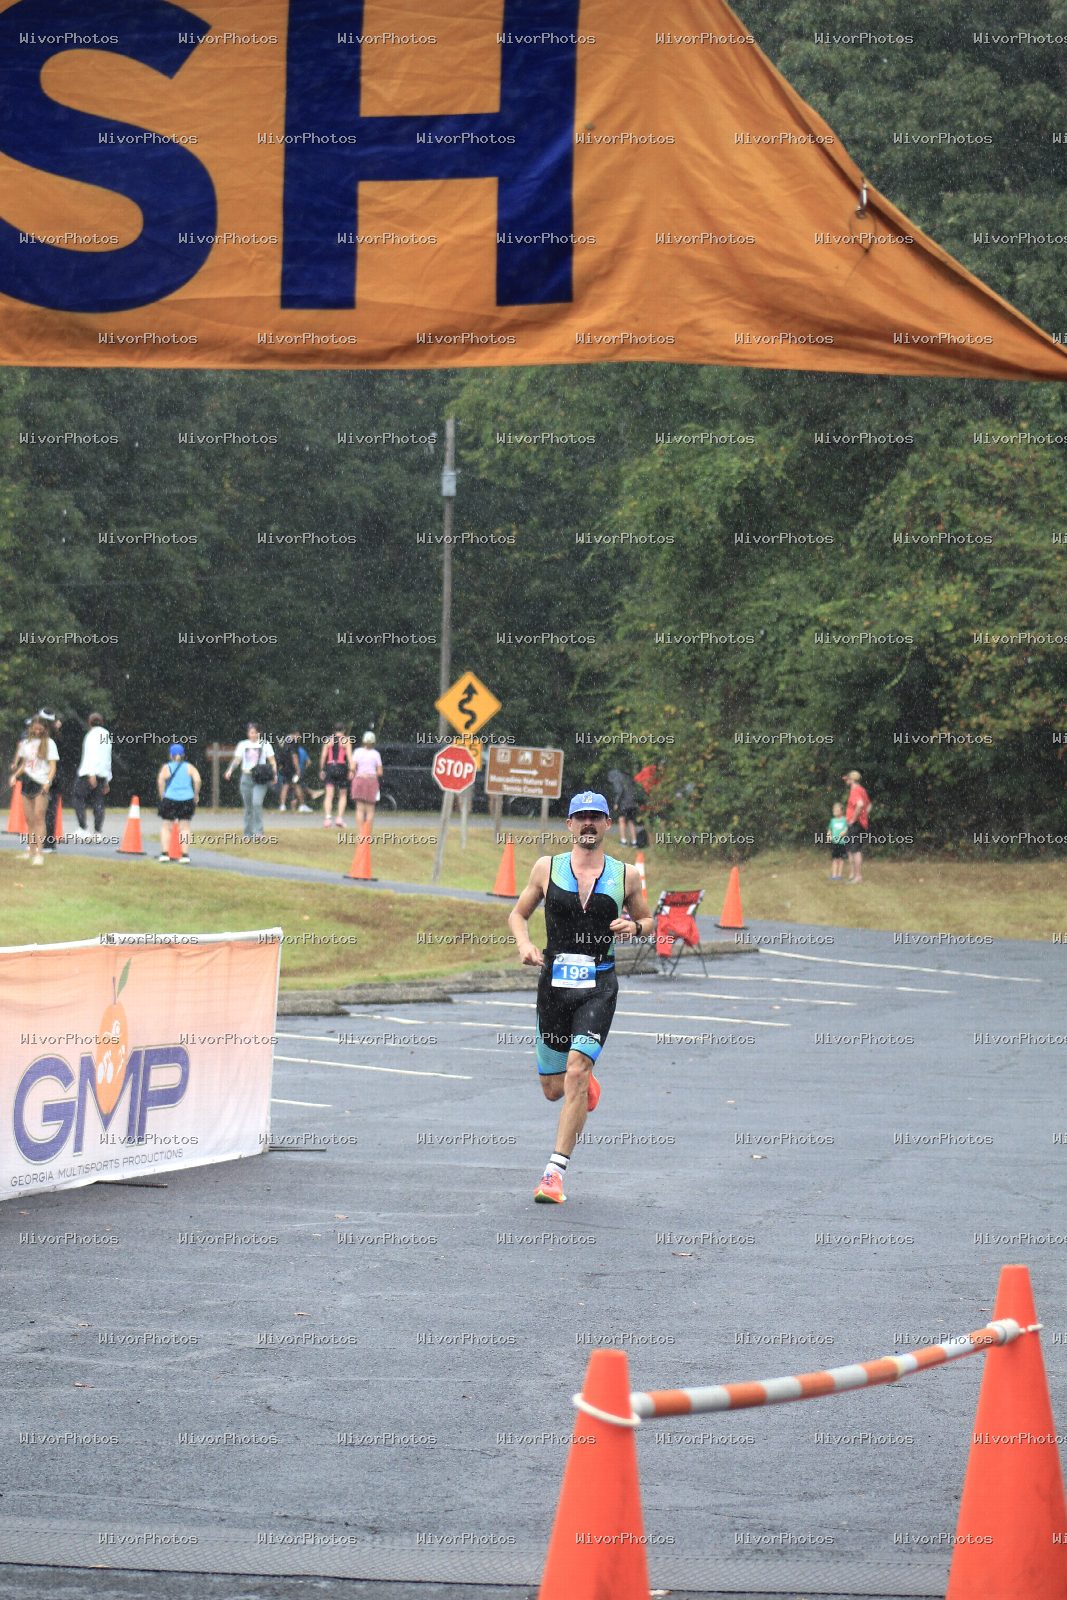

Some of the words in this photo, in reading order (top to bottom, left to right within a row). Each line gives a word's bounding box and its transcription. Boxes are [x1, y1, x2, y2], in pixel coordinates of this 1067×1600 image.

[0, 0, 579, 313] SH
[436, 757, 473, 779] STOP
[561, 965, 589, 980] 198
[13, 1043, 190, 1166] GMP
[10, 1170, 54, 1187] GEORGIA
[58, 1160, 120, 1180] MULTISPORTS
[123, 1149, 184, 1168] PRODUCTIONS
